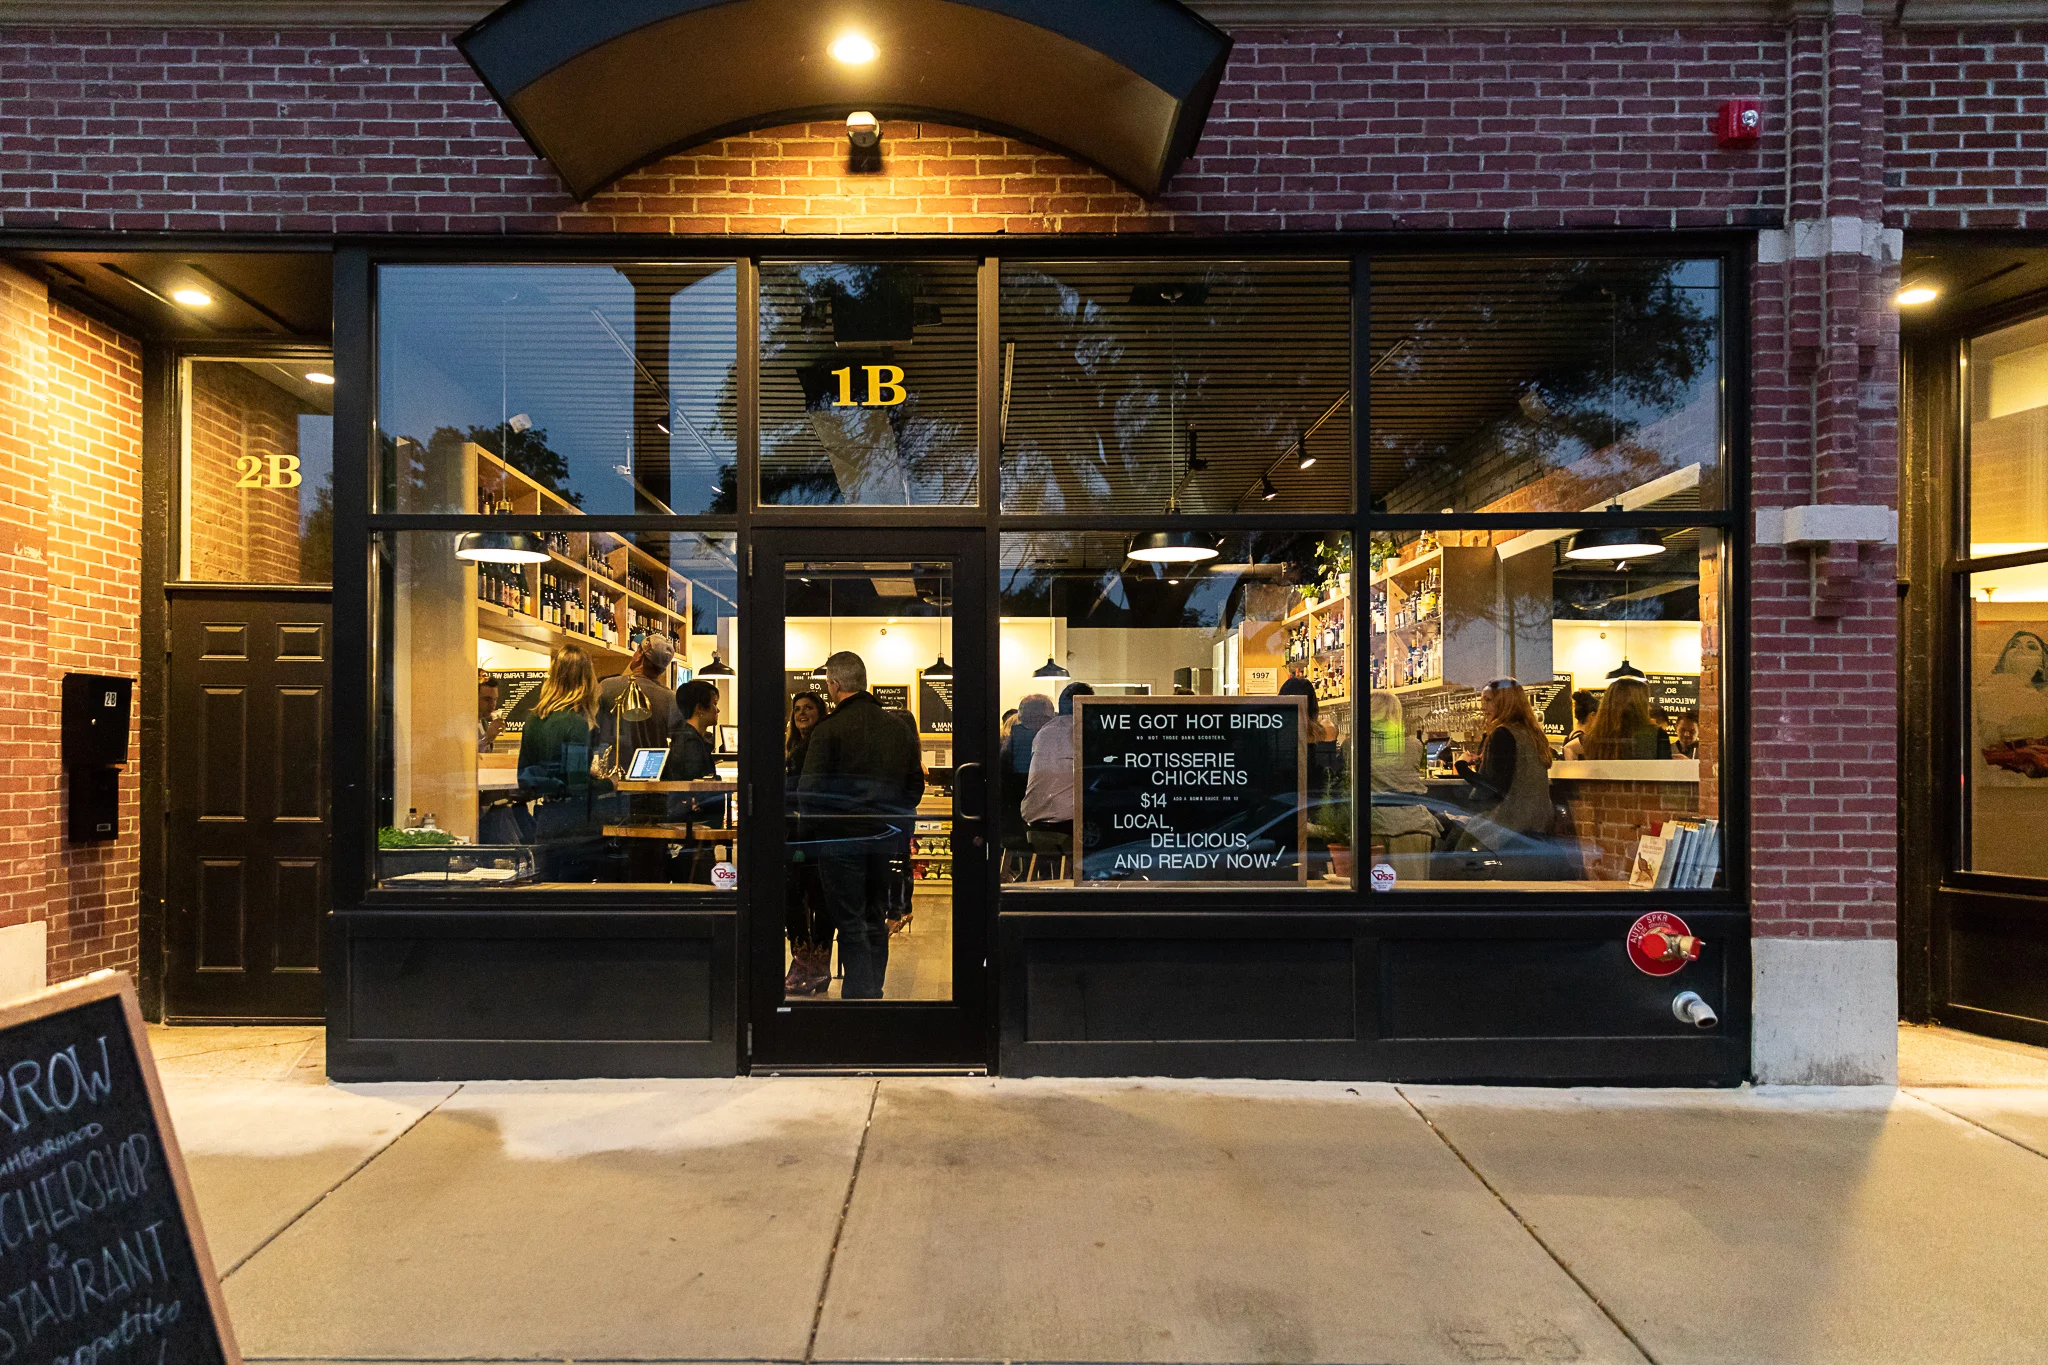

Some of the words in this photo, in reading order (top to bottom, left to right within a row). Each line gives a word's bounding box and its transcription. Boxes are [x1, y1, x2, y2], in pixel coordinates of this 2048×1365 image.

[831, 365, 907, 407] 1B
[235, 454, 303, 488] 2B
[809, 683, 822, 691] SO,
[105, 692, 116, 705] 2B
[1100, 714, 1131, 730] WE
[1138, 714, 1178, 730] GOT
[1186, 714, 1224, 730] HOT
[1230, 714, 1283, 730] BIRDS
[1124, 753, 1235, 768] ROTISSERIE
[1151, 770, 1248, 786] CHICKENS
[1140, 792, 1167, 809] $14
[1151, 833, 1250, 850] DELICIOUS,
[1114, 854, 1152, 869] AND
[1158, 854, 1220, 869] READY
[1630, 922, 1644, 943] AUTO
[1646, 914, 1668, 923] SPKR
[0, 1133, 150, 1256] CHERSHOP
[47, 1242, 68, 1269] &
